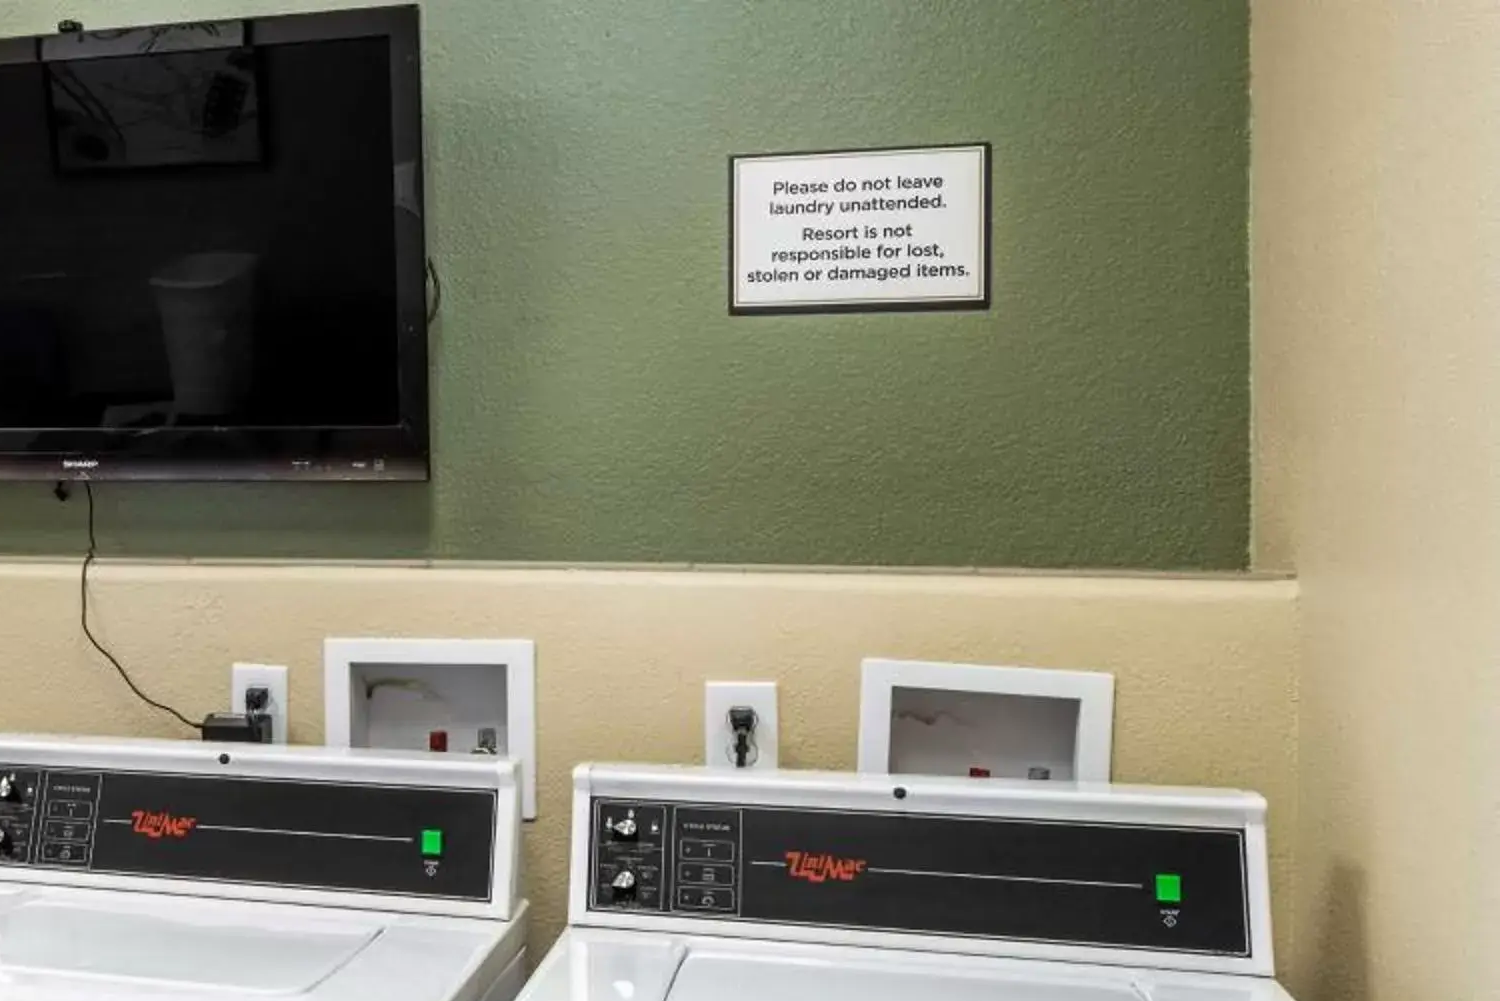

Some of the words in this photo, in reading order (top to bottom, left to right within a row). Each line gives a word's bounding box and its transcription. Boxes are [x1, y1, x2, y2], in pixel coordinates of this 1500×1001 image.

[773, 181, 829, 195] Please
[834, 178, 857, 192] do
[862, 177, 891, 191] not
[897, 175, 943, 189] leave
[769, 201, 834, 216] laundry
[840, 196, 947, 213] unattended.
[802, 227, 859, 241] Resort
[864, 225, 878, 239] is
[883, 224, 913, 238] not
[771, 246, 871, 264] responsible
[877, 245, 902, 259] for
[907, 243, 945, 259] lost,
[747, 269, 799, 283] stolen
[804, 270, 823, 281] or
[828, 264, 911, 281] damaged
[917, 263, 971, 278] items.
